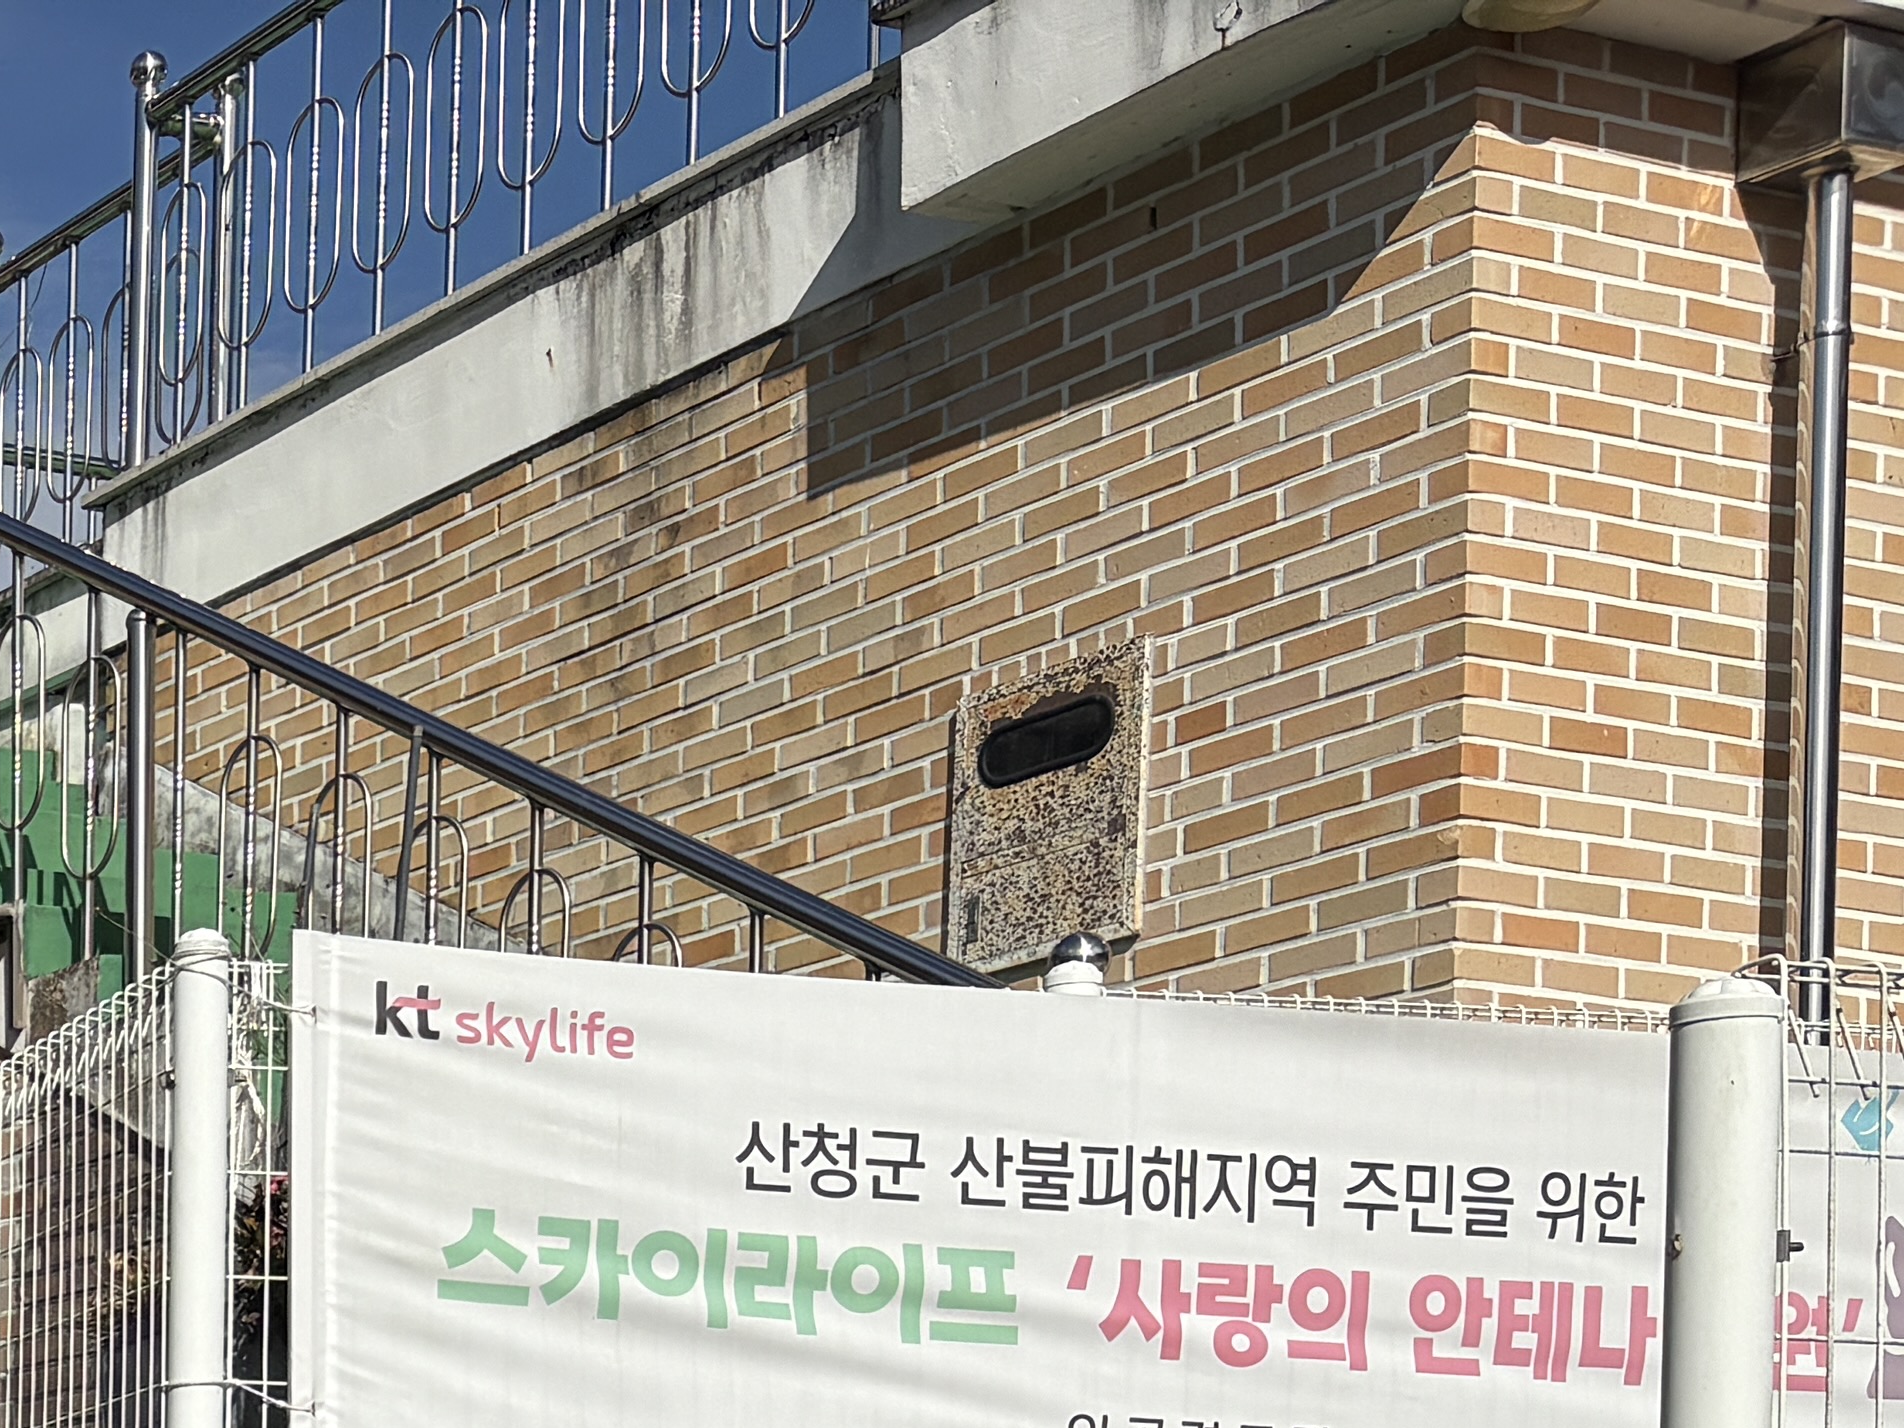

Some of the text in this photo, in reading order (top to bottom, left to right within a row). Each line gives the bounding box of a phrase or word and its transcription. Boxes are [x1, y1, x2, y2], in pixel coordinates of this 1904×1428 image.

[375, 980, 635, 1062] kt skylife
[734, 1120, 1646, 1246] 산청군 산불피해지역 주민을 위한
[437, 1208, 1020, 1346] 스카이라이프
[1408, 1275, 1658, 1387] 안테나
